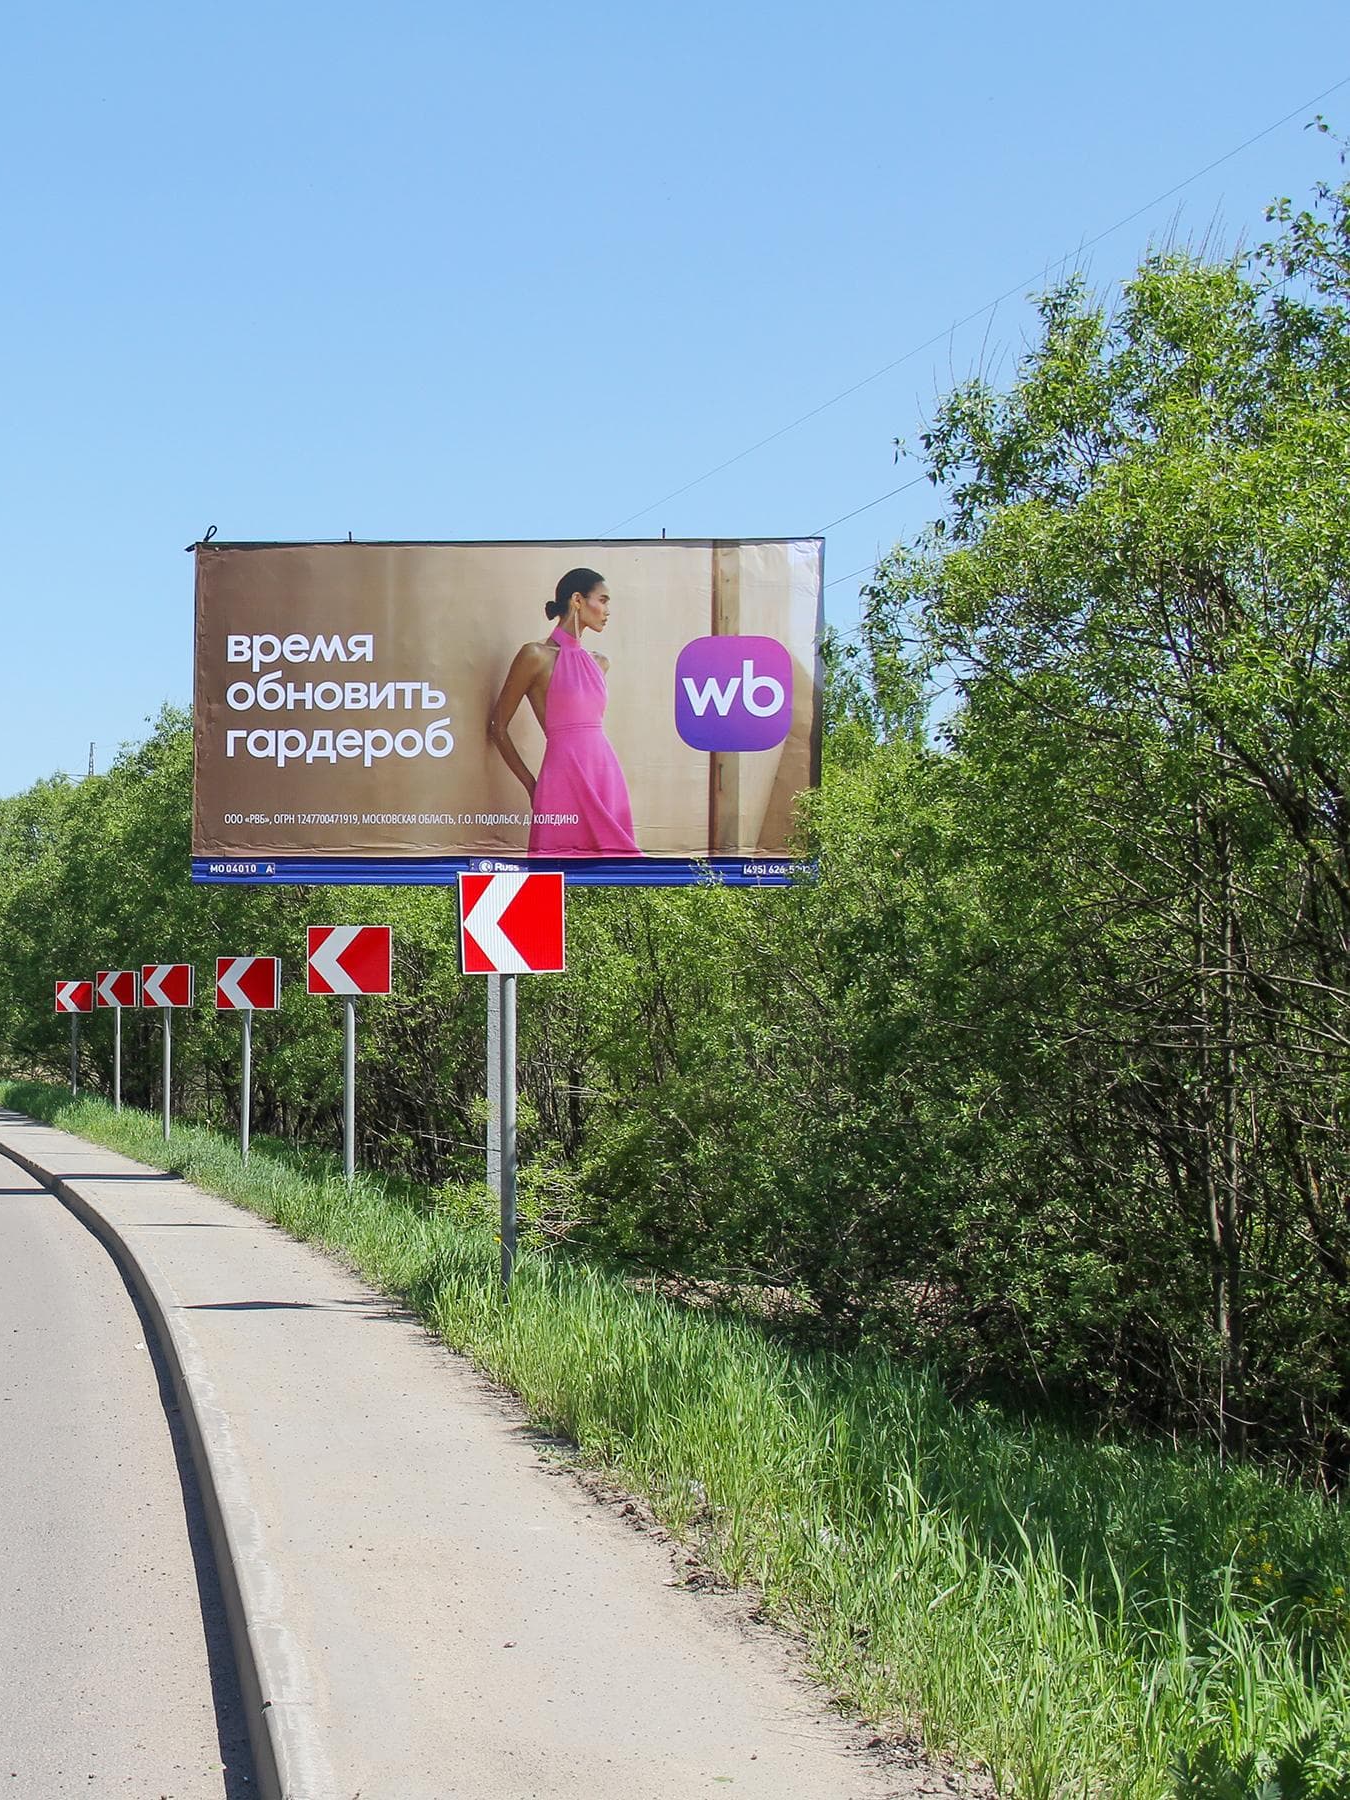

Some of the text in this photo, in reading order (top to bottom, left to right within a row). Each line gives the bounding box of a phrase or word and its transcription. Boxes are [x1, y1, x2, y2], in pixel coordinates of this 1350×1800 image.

[227, 634, 374, 673] время
[226, 670, 446, 711] обновить
[681, 659, 785, 718] wb
[226, 717, 454, 768] гардероб
[224, 813, 243, 825] ООО
[273, 813, 295, 825] ОГРН
[362, 813, 416, 825] МОСКОВСКАЯ
[418, 813, 456, 826] ОБЛАСТЬ,
[458, 813, 473, 825] Г.О.
[475, 813, 521, 827] ПОДОЛЬСК,
[533, 813, 579, 825] КОЛЕДИНО
[494, 862, 520, 872] Russ
[743, 864, 767, 875] (495)
